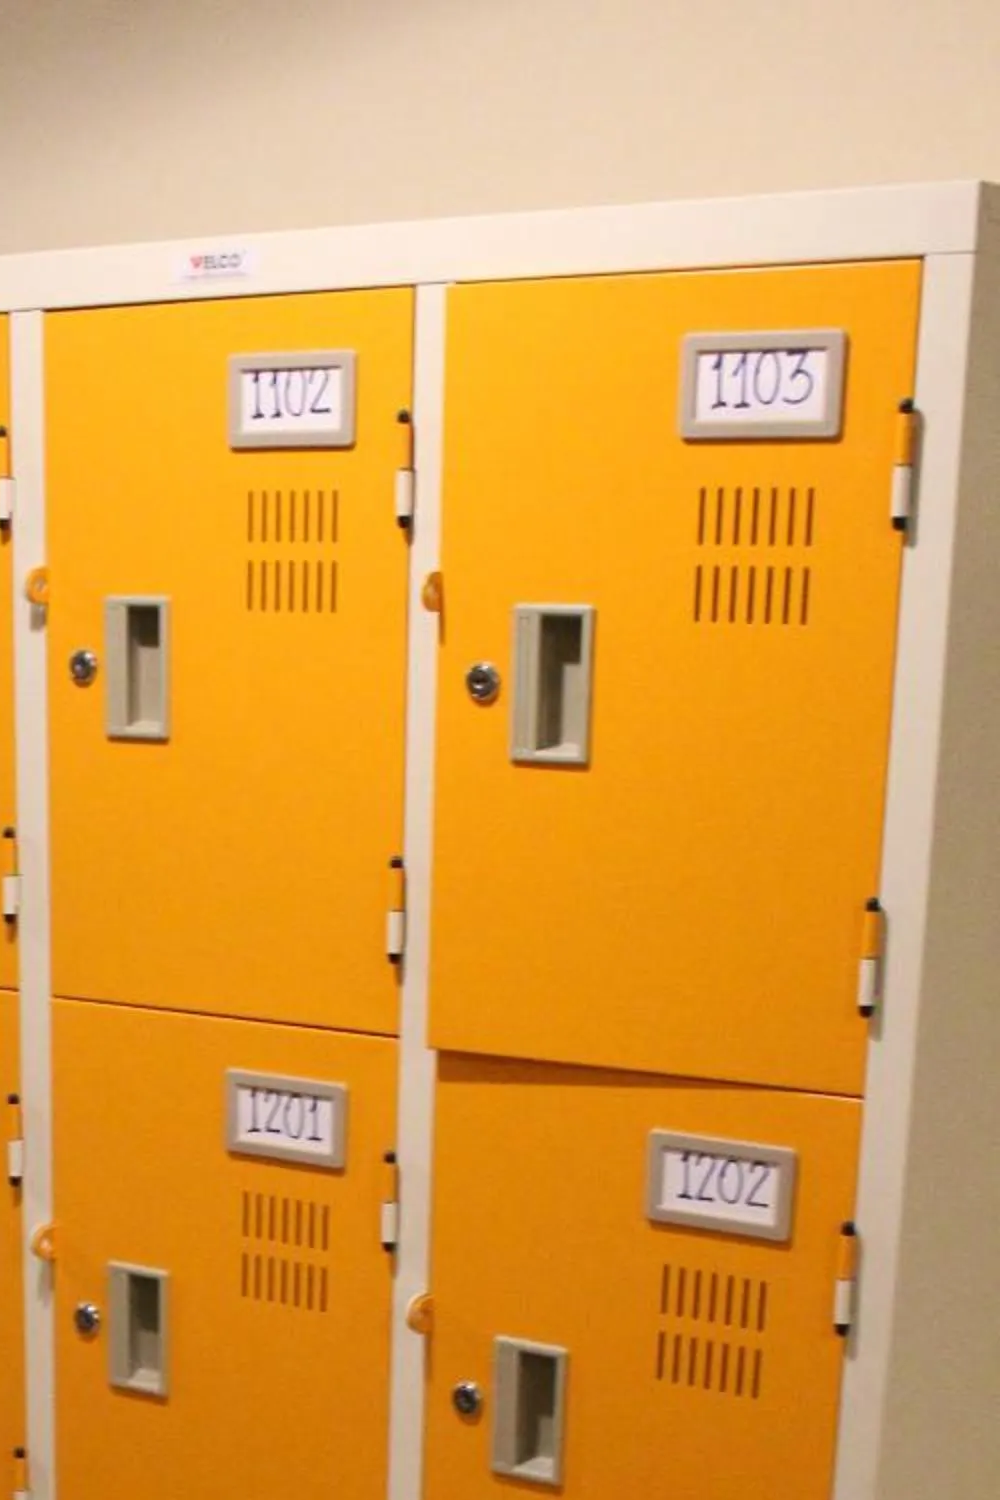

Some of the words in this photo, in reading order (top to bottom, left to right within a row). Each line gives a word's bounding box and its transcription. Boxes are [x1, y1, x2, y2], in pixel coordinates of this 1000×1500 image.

[251, 370, 332, 419] 1102
[710, 349, 815, 411] 1103
[247, 1086, 324, 1142] 1201
[677, 1150, 771, 1208] 1202
